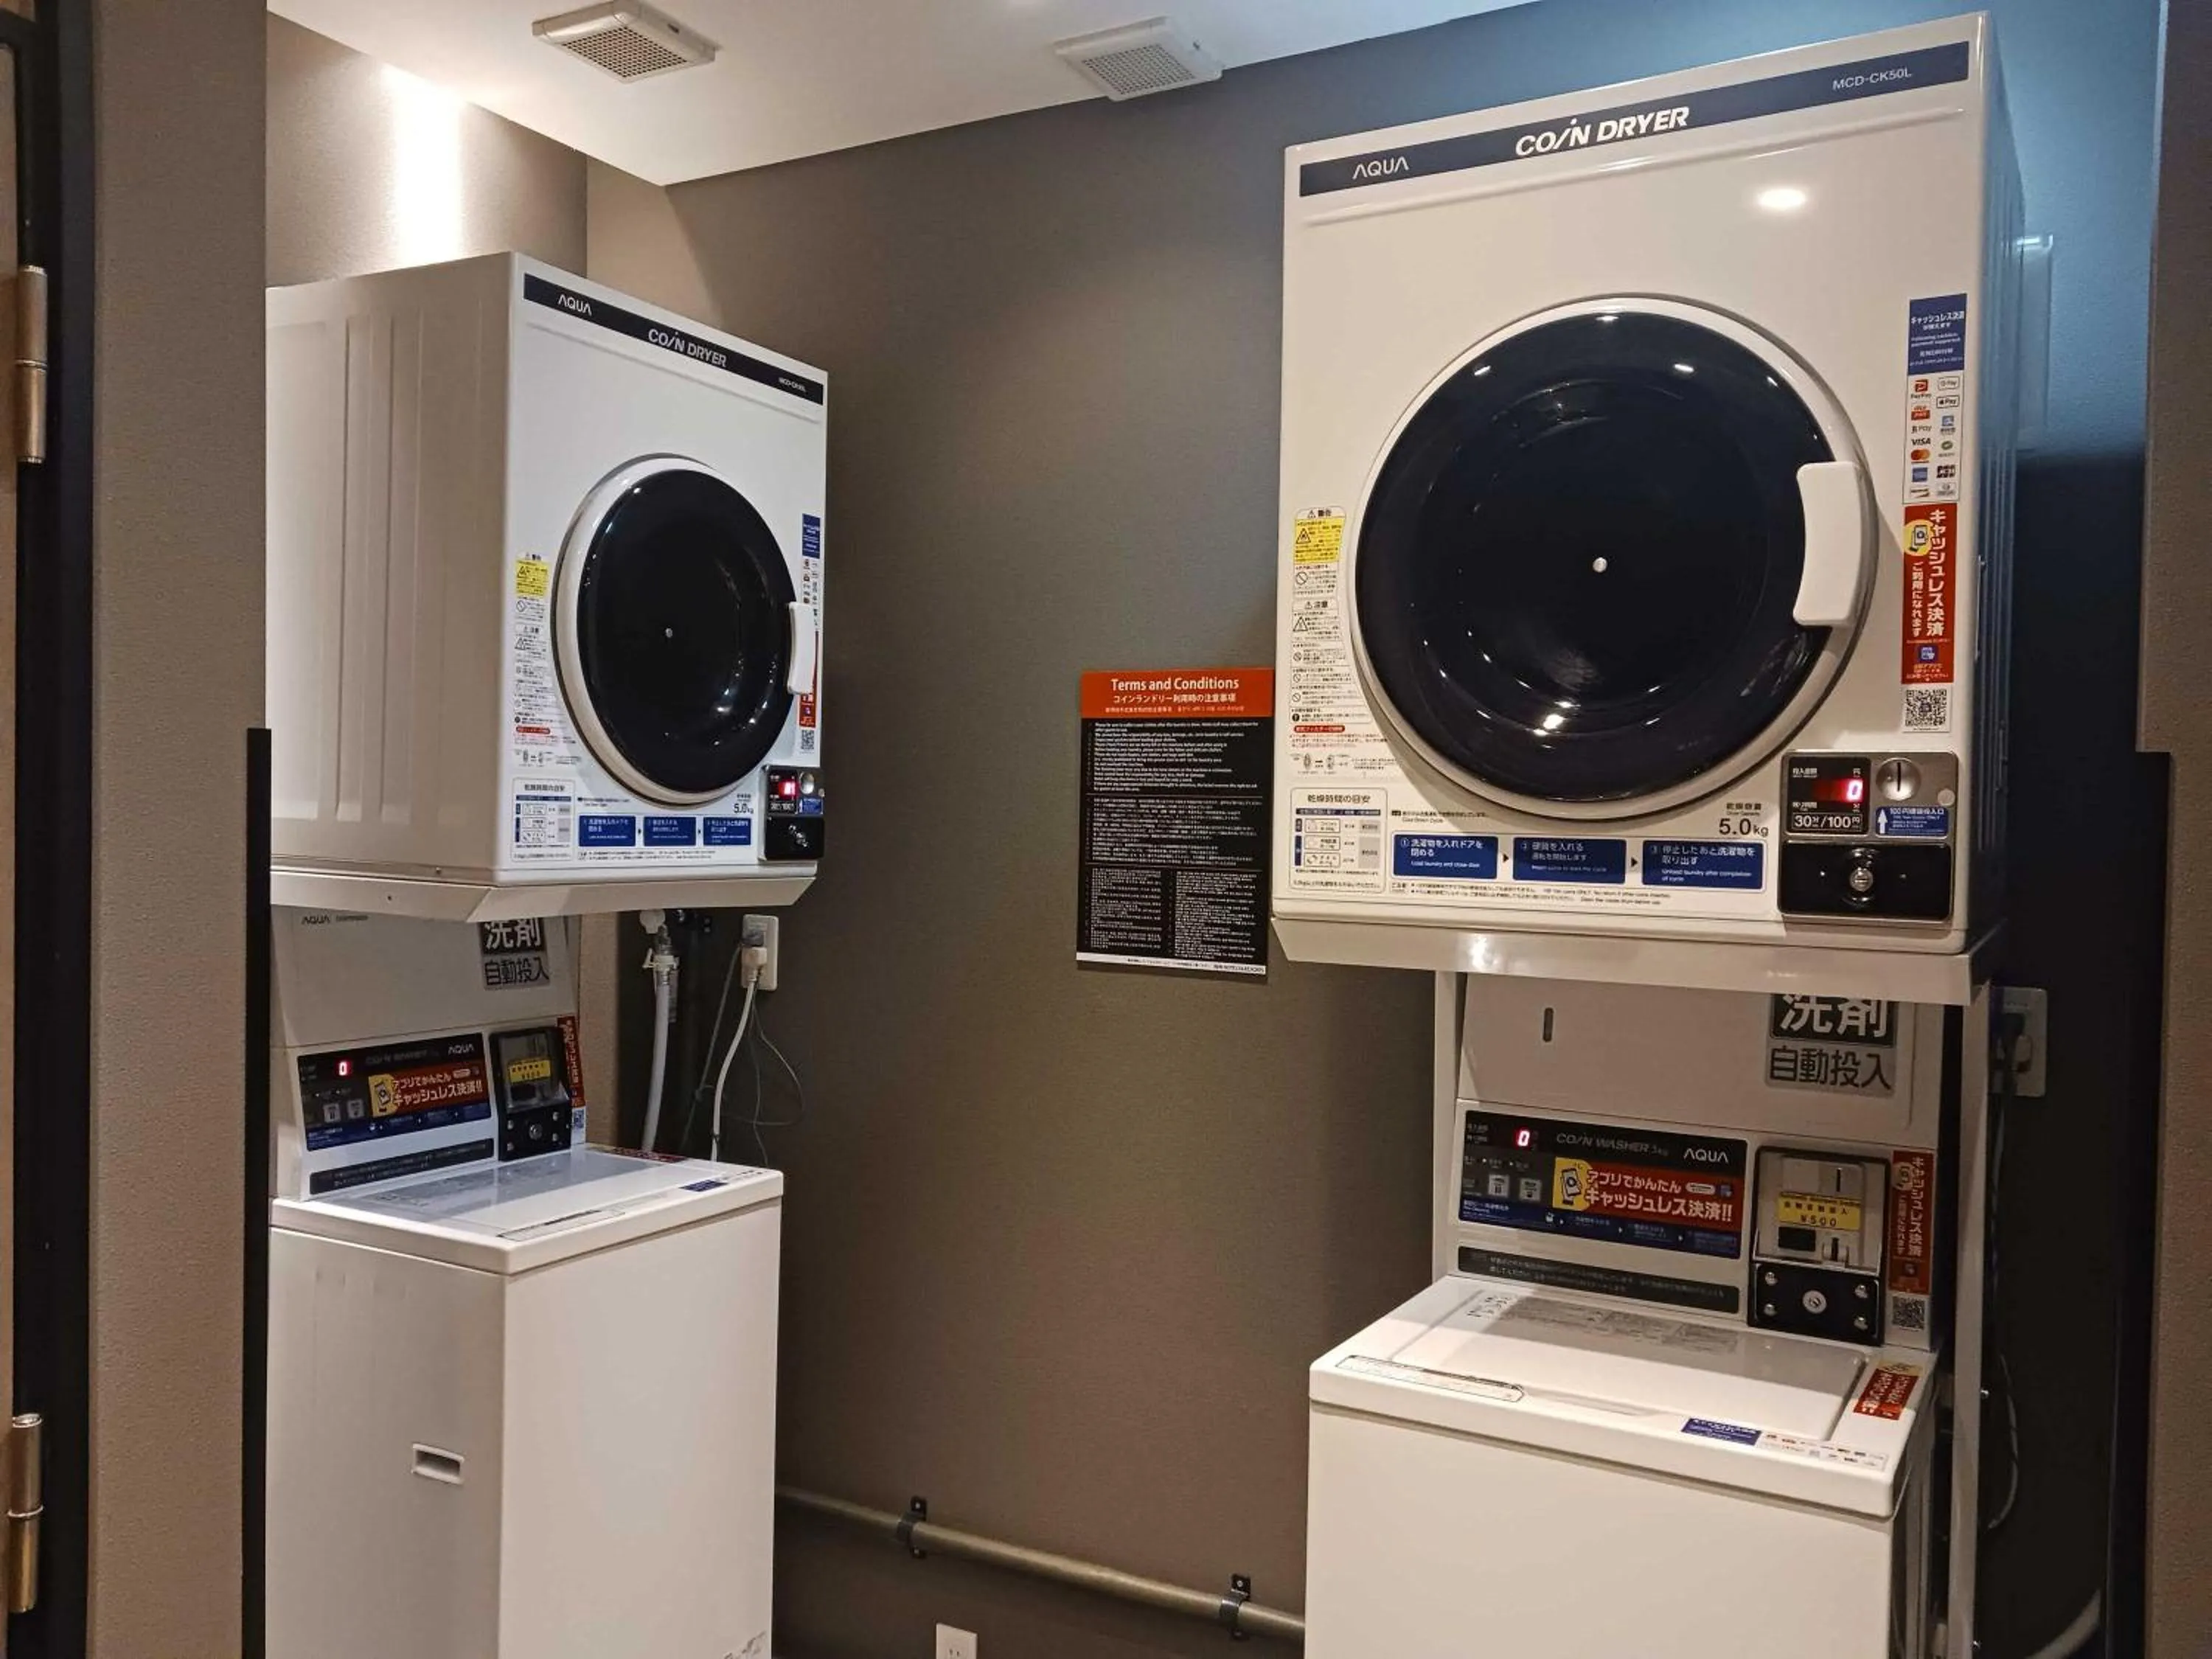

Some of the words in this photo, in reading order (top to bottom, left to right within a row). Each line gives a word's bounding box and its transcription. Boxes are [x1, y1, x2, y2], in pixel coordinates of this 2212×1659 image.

[1832, 66, 1913, 91] MCD-CK50L
[1596, 106, 1691, 145] DRYER
[1352, 156, 1410, 181] AQUA
[557, 293, 593, 317] AQUA
[686, 341, 728, 368] DRYER
[1926, 509, 1947, 636] キャッシュレス決済
[1110, 678, 1147, 691] Terms
[1148, 678, 1171, 690] and
[1173, 676, 1239, 690] Conditions
[1846, 779, 1863, 801] 0
[485, 917, 542, 950] 洗剤
[484, 958, 550, 987] 自動投入
[1780, 994, 1888, 1037] 洗剤
[338, 1061, 347, 1076] 0
[1770, 1045, 1891, 1091] 自動投入
[1517, 1130, 1531, 1147] 0
[1596, 1137, 1649, 1152] WASHER
[1683, 1147, 1729, 1164] AQUA
[1586, 1171, 1682, 1194] アプリでかんたん
